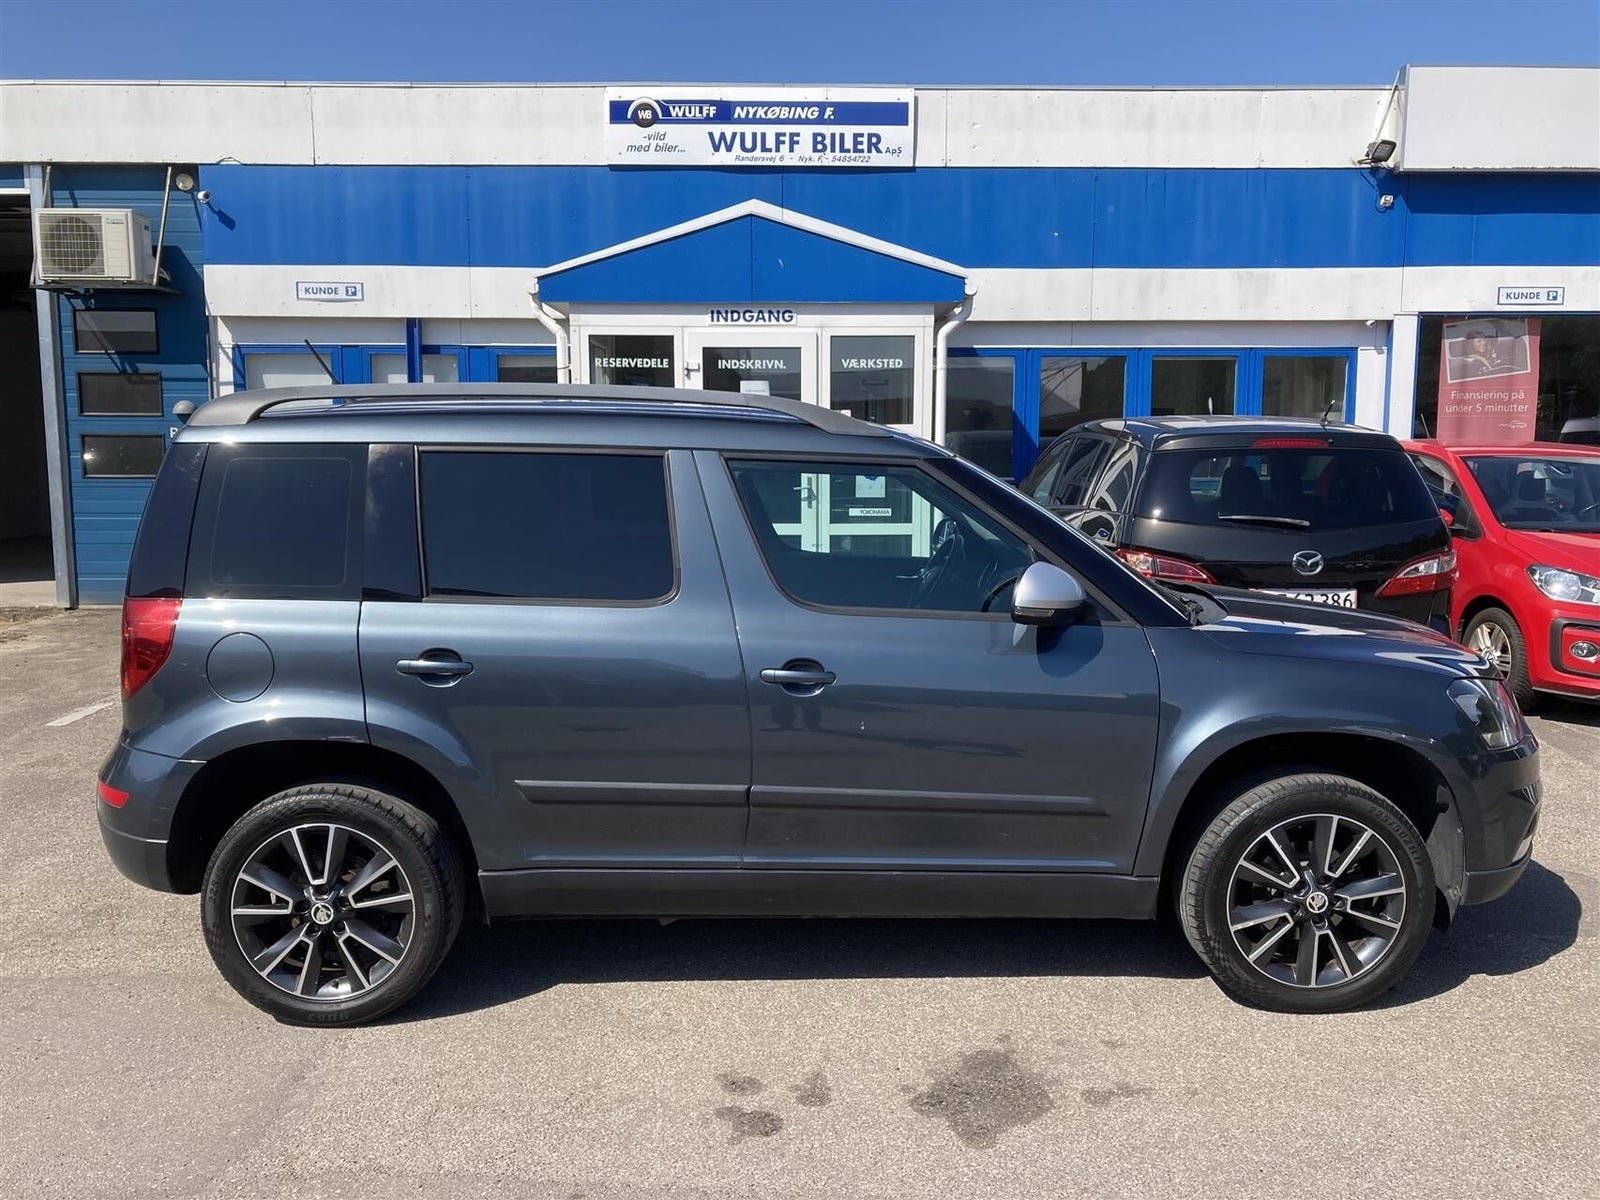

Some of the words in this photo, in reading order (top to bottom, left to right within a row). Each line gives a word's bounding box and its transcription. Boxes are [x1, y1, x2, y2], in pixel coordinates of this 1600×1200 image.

[669, 106, 717, 118] WULFF
[733, 106, 820, 119] NYKØBING
[823, 107, 835, 119] F.
[643, 131, 667, 141] -vild
[626, 143, 650, 153] med
[708, 131, 800, 153] WULFF
[812, 132, 882, 154] BILER
[885, 146, 903, 156] ApS
[734, 154, 777, 164] Randersvej
[778, 155, 785, 163] 6
[798, 155, 816, 164] Nyk.
[831, 155, 871, 164] 54854722
[304, 287, 339, 295] KUNDE
[1506, 291, 1541, 300] KUNDE
[710, 309, 794, 323] INDGANG
[595, 357, 669, 369] RESERVEDELE
[718, 359, 786, 370] INDSKRIVN.
[841, 358, 903, 369] VÆRKSTED
[1451, 390, 1509, 402] Finansiering
[1512, 390, 1525, 402] på
[1445, 403, 1473, 413] under
[1476, 403, 1482, 412] 5
[1485, 403, 1529, 413] minutter
